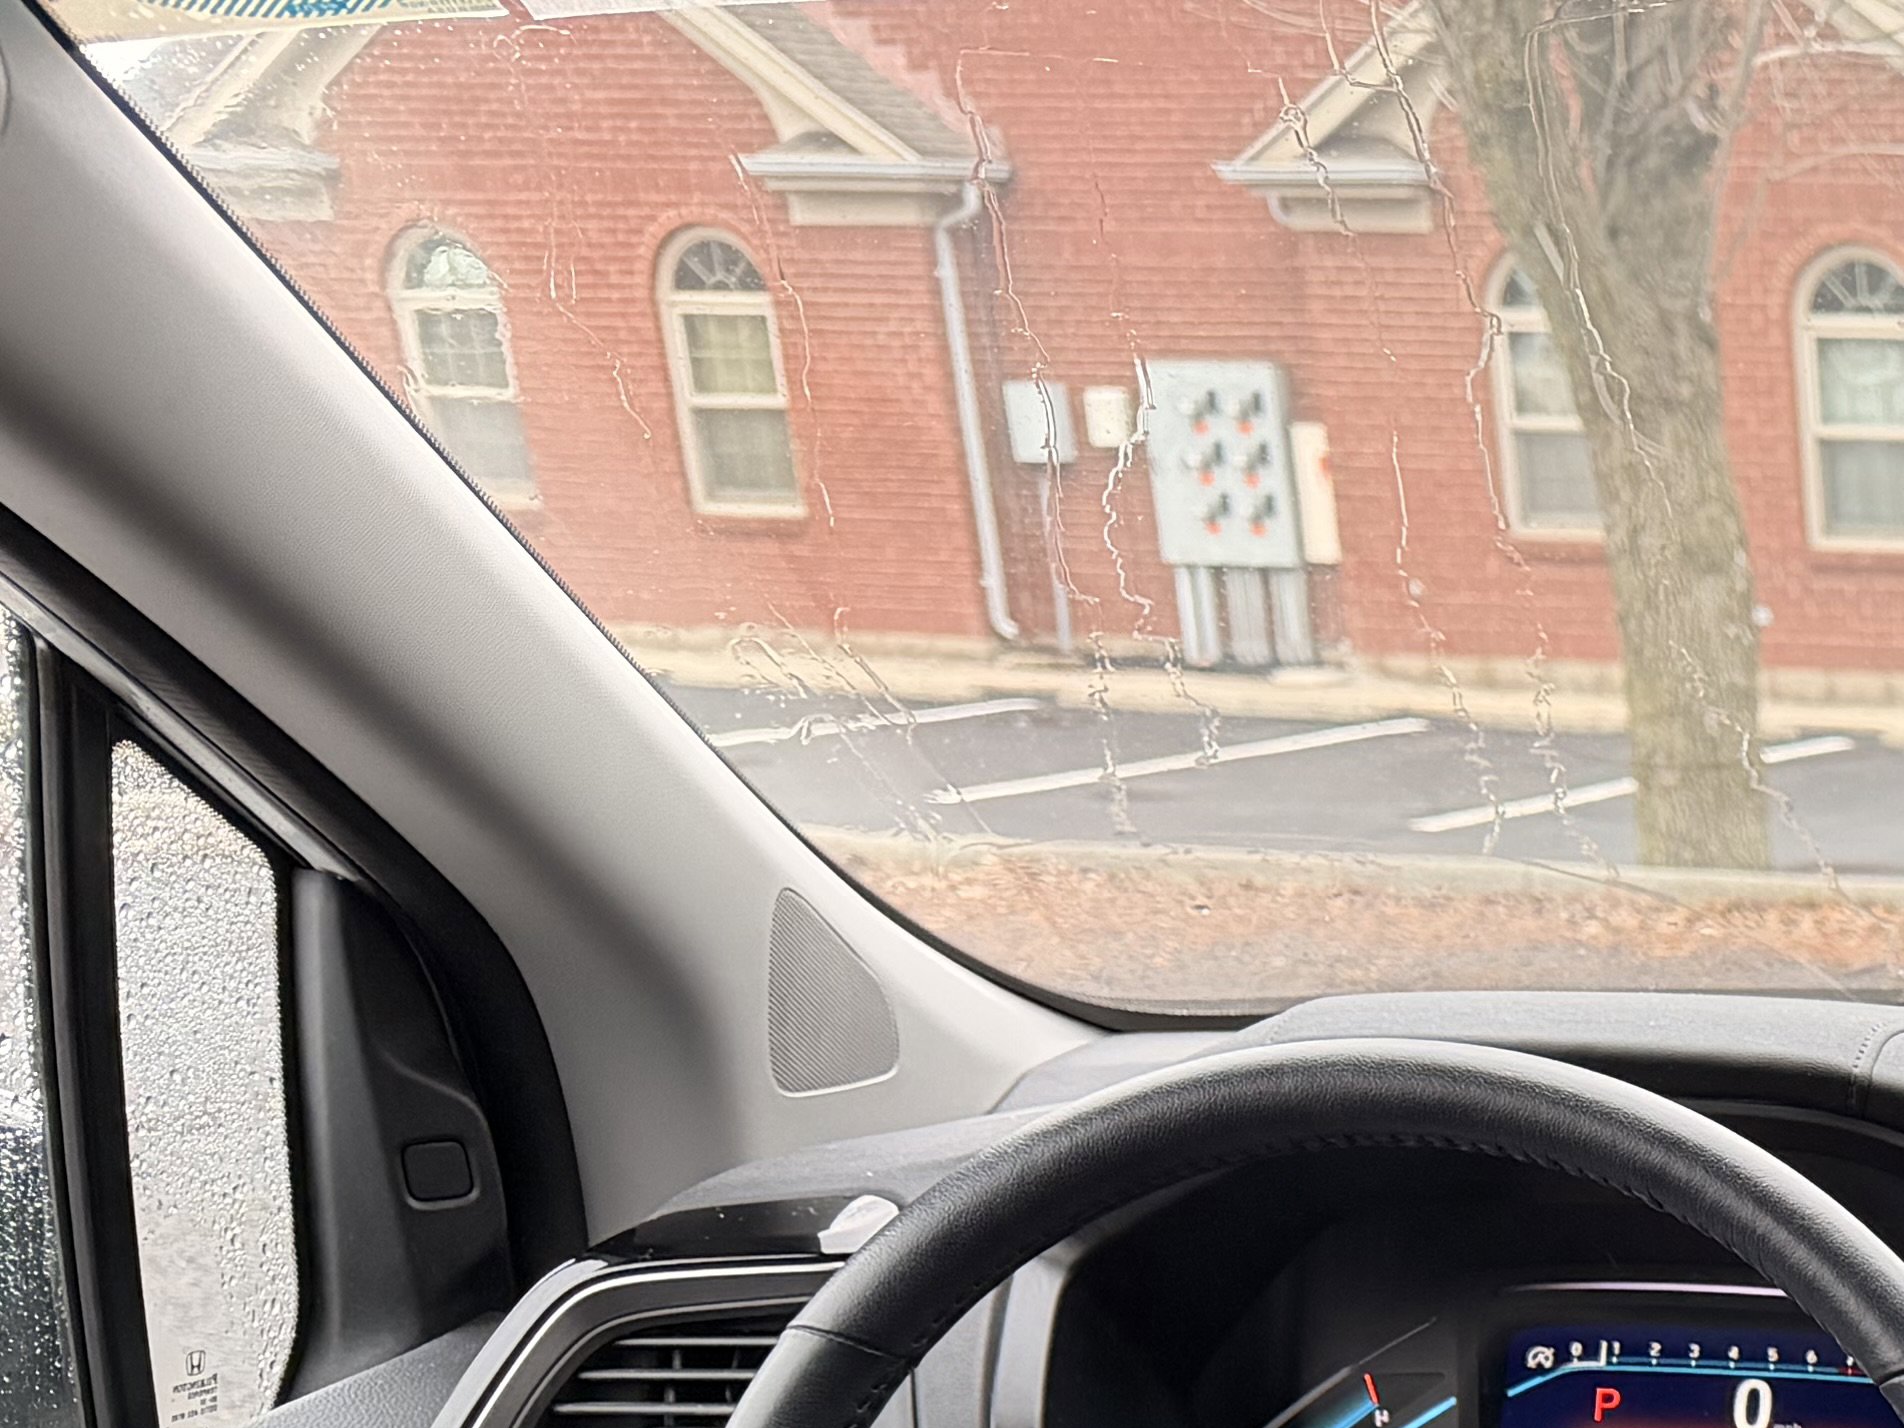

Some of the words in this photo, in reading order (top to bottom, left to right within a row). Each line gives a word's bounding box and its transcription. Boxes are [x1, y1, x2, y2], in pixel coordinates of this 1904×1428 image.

[1570, 1341, 1584, 1357] 0
[1649, 1341, 1663, 1358] 2
[1688, 1342, 1701, 1359] 3
[1766, 1346, 1780, 1363] 5
[1594, 1387, 1621, 1423] P
[1374, 1409, 1390, 1427] H
